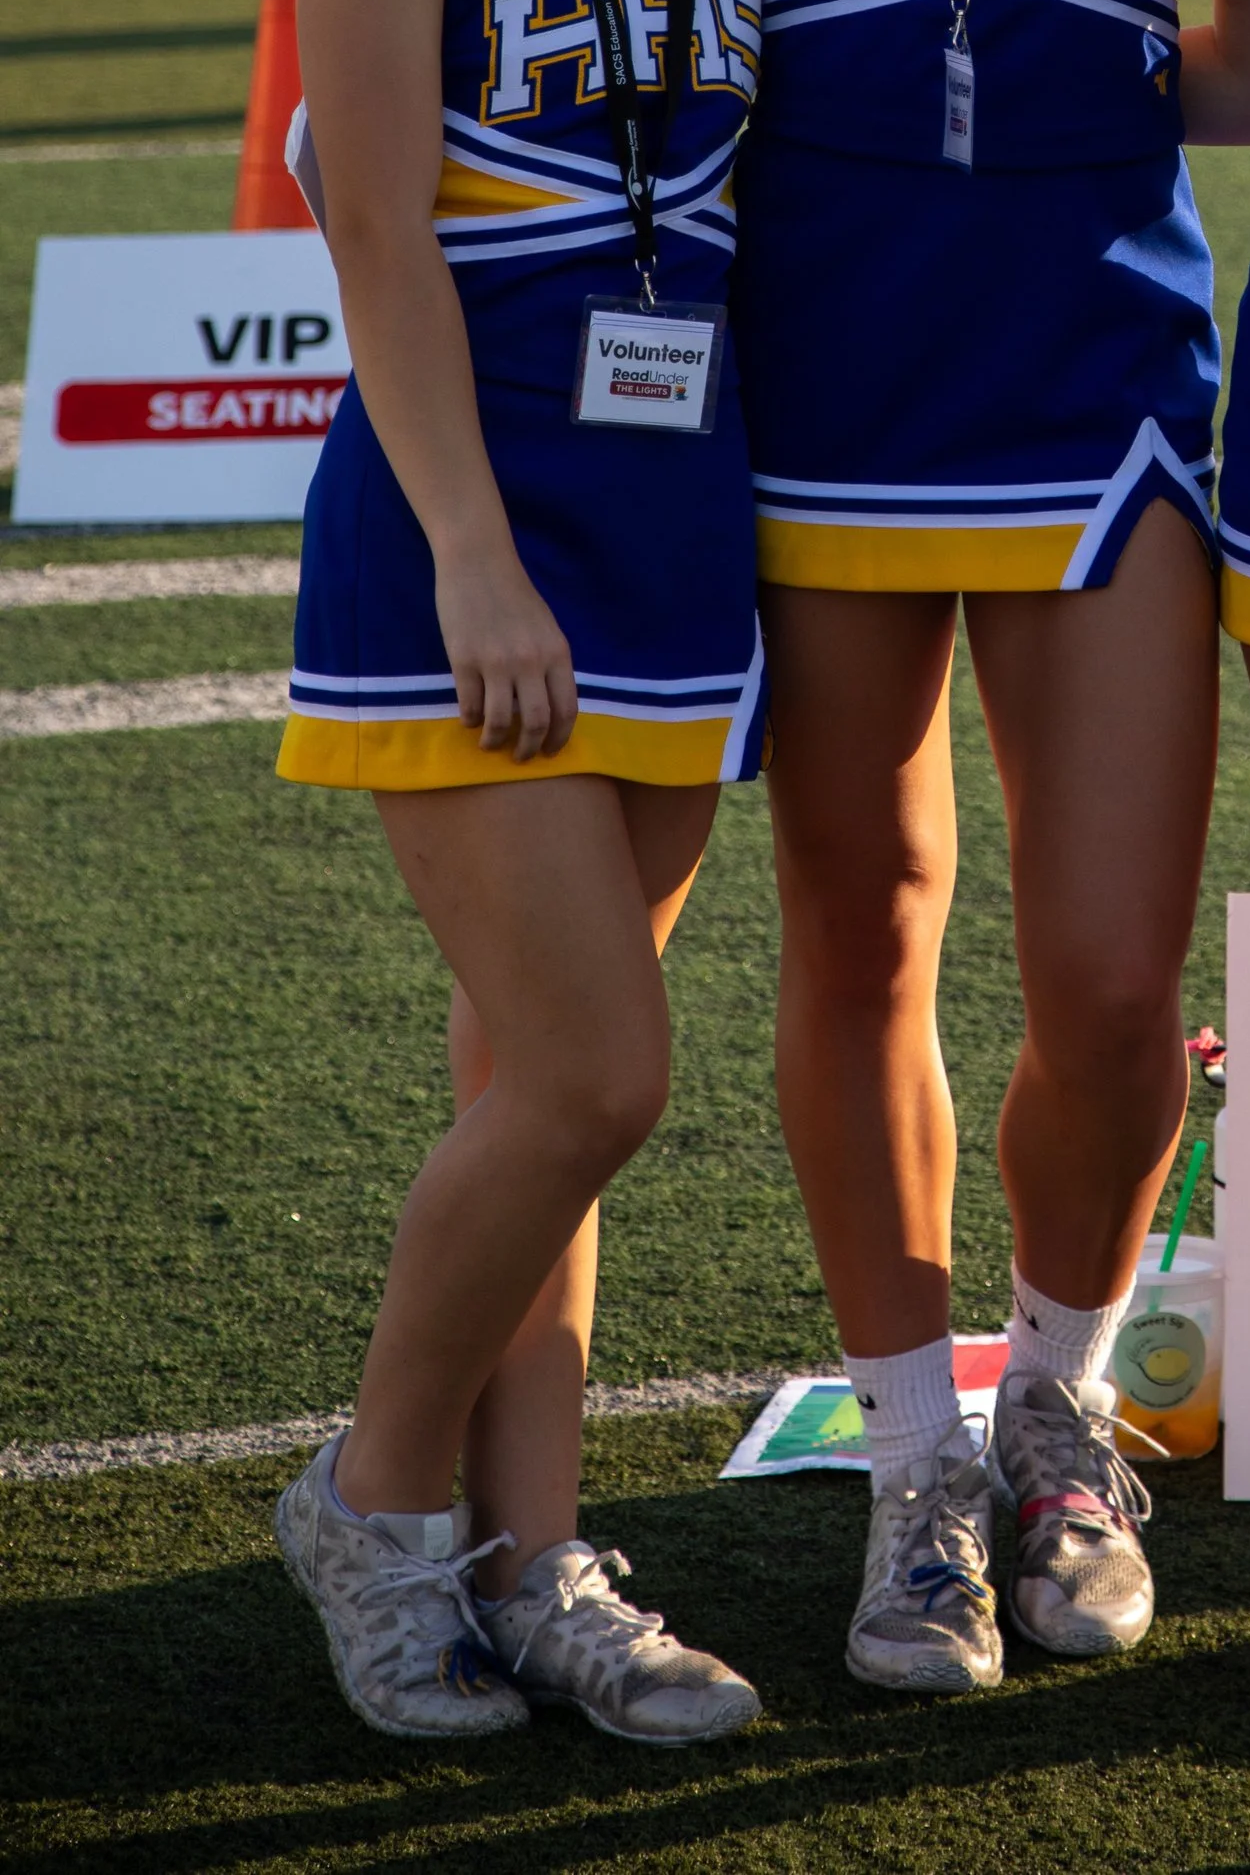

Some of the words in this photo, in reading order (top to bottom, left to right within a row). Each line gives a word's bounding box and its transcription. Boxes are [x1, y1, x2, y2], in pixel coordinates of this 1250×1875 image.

[604, 2, 621, 52] Education
[612, 54, 626, 85] SACS
[197, 312, 332, 365] VIP
[599, 338, 705, 365] Volunteer
[612, 367, 689, 385] ReadUnder
[616, 384, 633, 393] THE
[636, 385, 668, 396] LIGHTS
